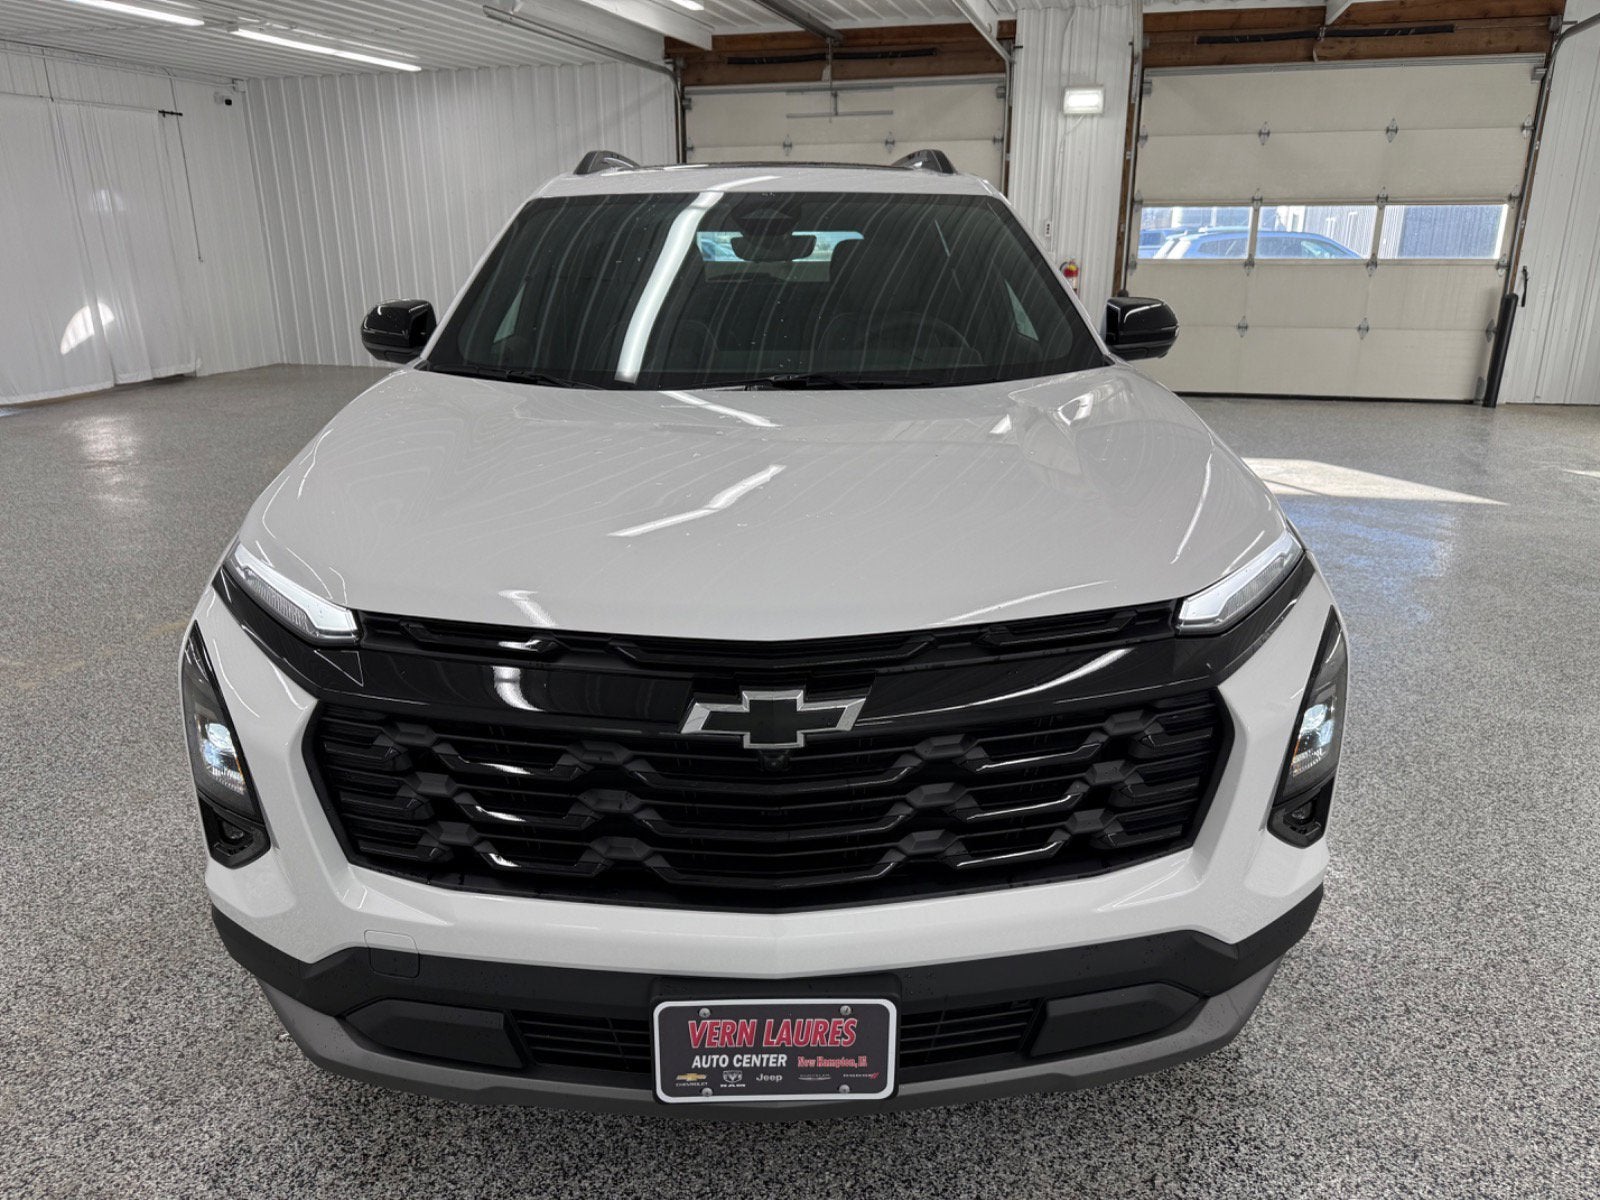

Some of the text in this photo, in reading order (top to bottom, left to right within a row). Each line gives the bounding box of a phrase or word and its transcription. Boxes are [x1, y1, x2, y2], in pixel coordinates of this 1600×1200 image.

[688, 1018, 858, 1048] VERN LAURES
[691, 1053, 787, 1069] AUTO CENTER
[797, 1056, 816, 1067] New
[817, 1056, 857, 1068] Hampton,
[755, 1073, 783, 1082] Jeep
